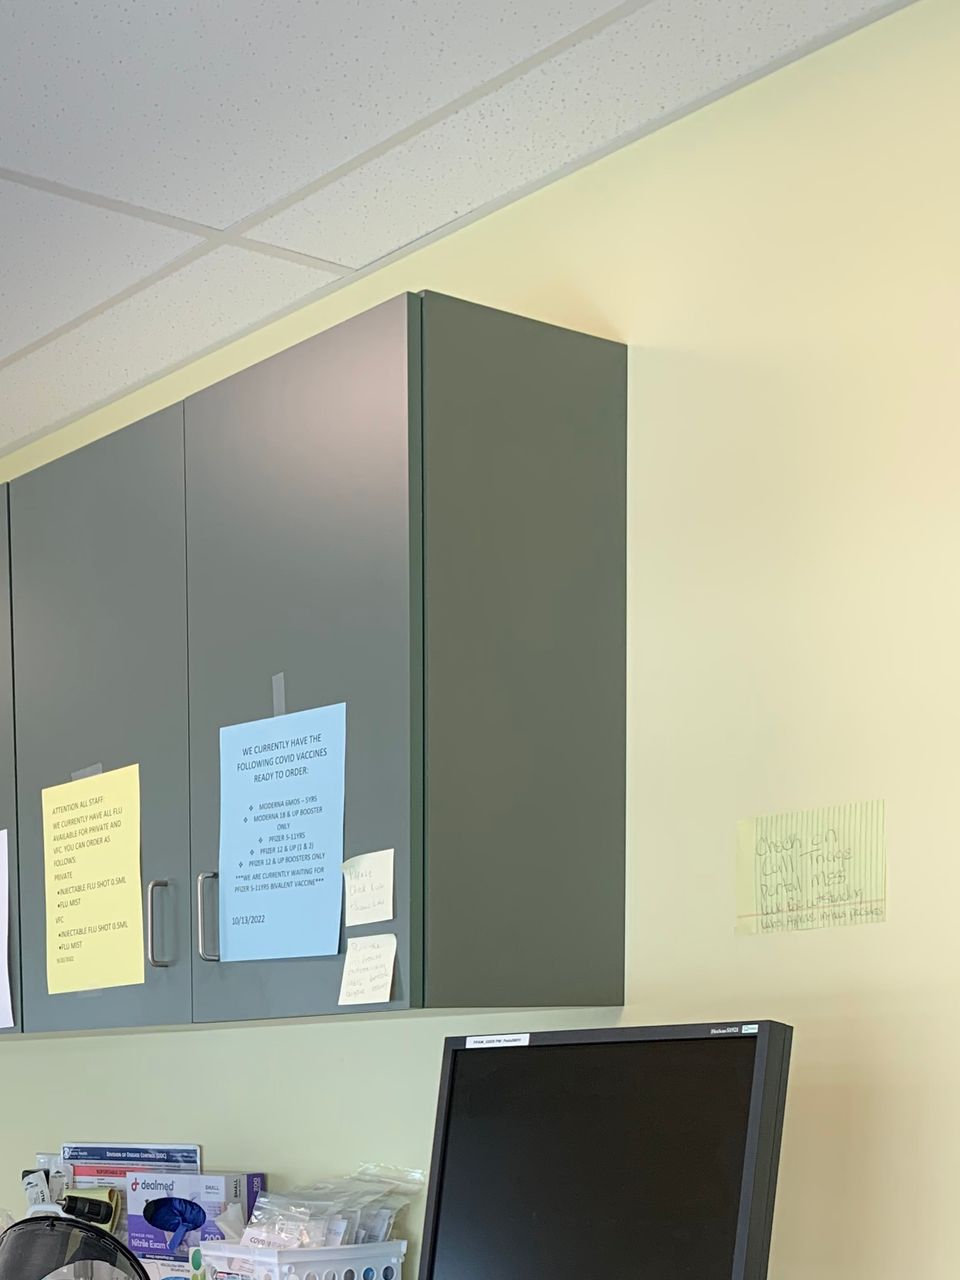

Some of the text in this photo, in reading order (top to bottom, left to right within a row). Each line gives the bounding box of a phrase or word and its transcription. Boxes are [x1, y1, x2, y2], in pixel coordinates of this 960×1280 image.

[242, 733, 322, 756] WE CURRENTLY HAVE THE
[237, 747, 328, 771] FOLLOWING COVID VACCINES
[254, 772, 274, 783] READY
[275, 770, 284, 779] TO
[52, 802, 79, 815] ATTENTION
[80, 800, 88, 808] ALL
[259, 801, 284, 810] MODERNA
[52, 807, 123, 830] WE CURRENTLY HAVE ALL FLU
[253, 813, 279, 822] MODERNA
[300, 806, 323, 816] BOOSTER
[53, 819, 122, 842] AVAILABLE FOR PRIVATE AND
[277, 823, 290, 831] ONLY
[63, 844, 75, 853] YOU
[75, 841, 86, 850] CAN
[86, 837, 104, 848] ORDER
[104, 835, 111, 843] AS
[269, 834, 285, 843] PFIZER
[260, 846, 276, 855] PFIZER
[248, 858, 264, 867] PFIZER
[285, 853, 311, 863] BOOSTERS
[312, 852, 325, 860] ONLY
[252, 872, 261, 880] ARE
[262, 870, 290, 879] CURRENTLY
[291, 867, 313, 876] WAITING
[314, 866, 324, 874] FOR
[86, 882, 96, 891] FLU
[97, 879, 110, 889] SHOT
[235, 885, 249, 893] PFIZER
[270, 881, 293, 890] BIVALENT
[232, 914, 265, 926] 10/13/2022
[88, 926, 97, 934] FLU
[98, 922, 111, 933] SHOT
[141, 1180, 174, 1191] dealmed
[131, 1239, 166, 1249] Nitrile Exam
